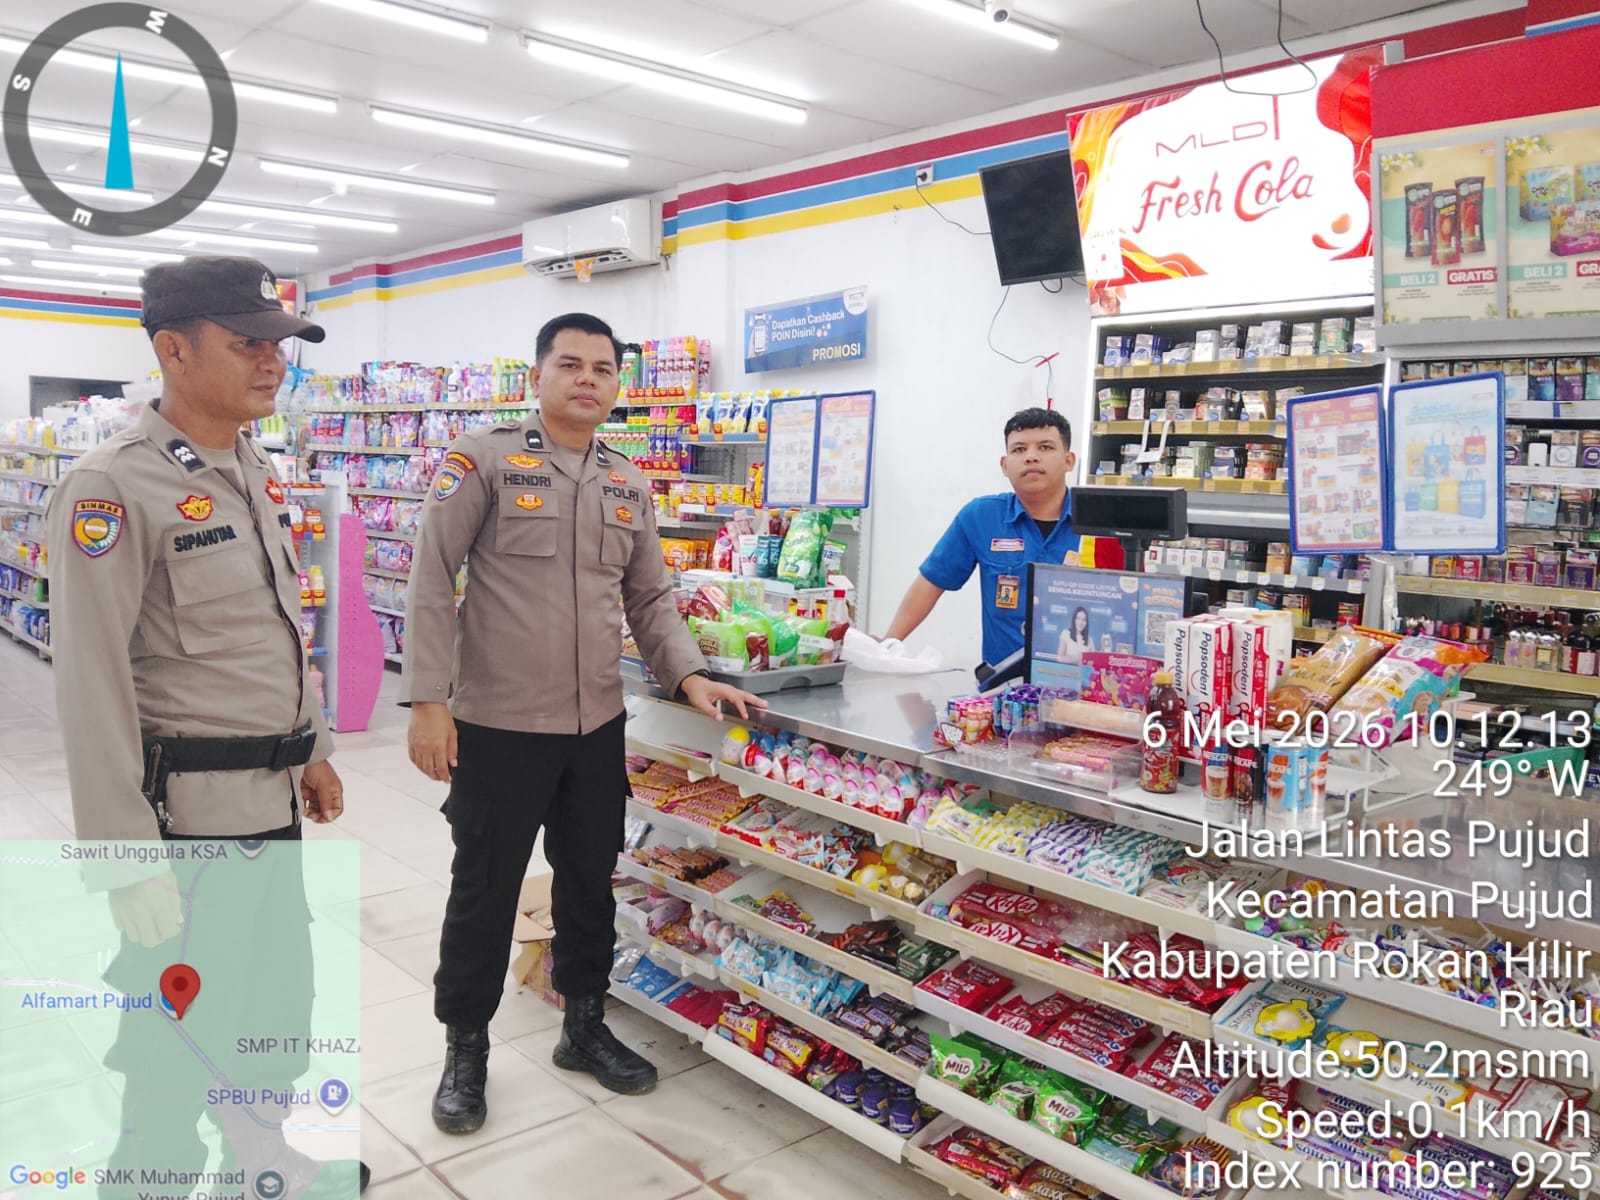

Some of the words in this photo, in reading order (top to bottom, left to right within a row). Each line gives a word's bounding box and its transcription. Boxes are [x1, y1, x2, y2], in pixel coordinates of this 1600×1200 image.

[1133, 170, 1222, 234] Fresh
[1234, 156, 1314, 222] Cola
[1400, 274, 1426, 286] BELI
[1427, 273, 1436, 284] 2
[1449, 269, 1495, 283] GRATIS
[1524, 266, 1552, 278] BELI
[1554, 265, 1564, 276] 2
[772, 317, 806, 331] Dapatkan
[808, 310, 845, 325] Cashback
[792, 326, 816, 339] Disini!
[812, 342, 861, 361] PROMOSI
[504, 472, 551, 488] HENDRI
[602, 485, 640, 502] POLRI
[1174, 628, 1186, 692] Pepsodent
[1199, 632, 1212, 696] Pepsodent
[1240, 632, 1252, 696] Pepsodent
[988, 894, 1036, 914] KitKat
[944, 1060, 970, 1076] MILO
[1048, 1098, 1076, 1120] MILO
